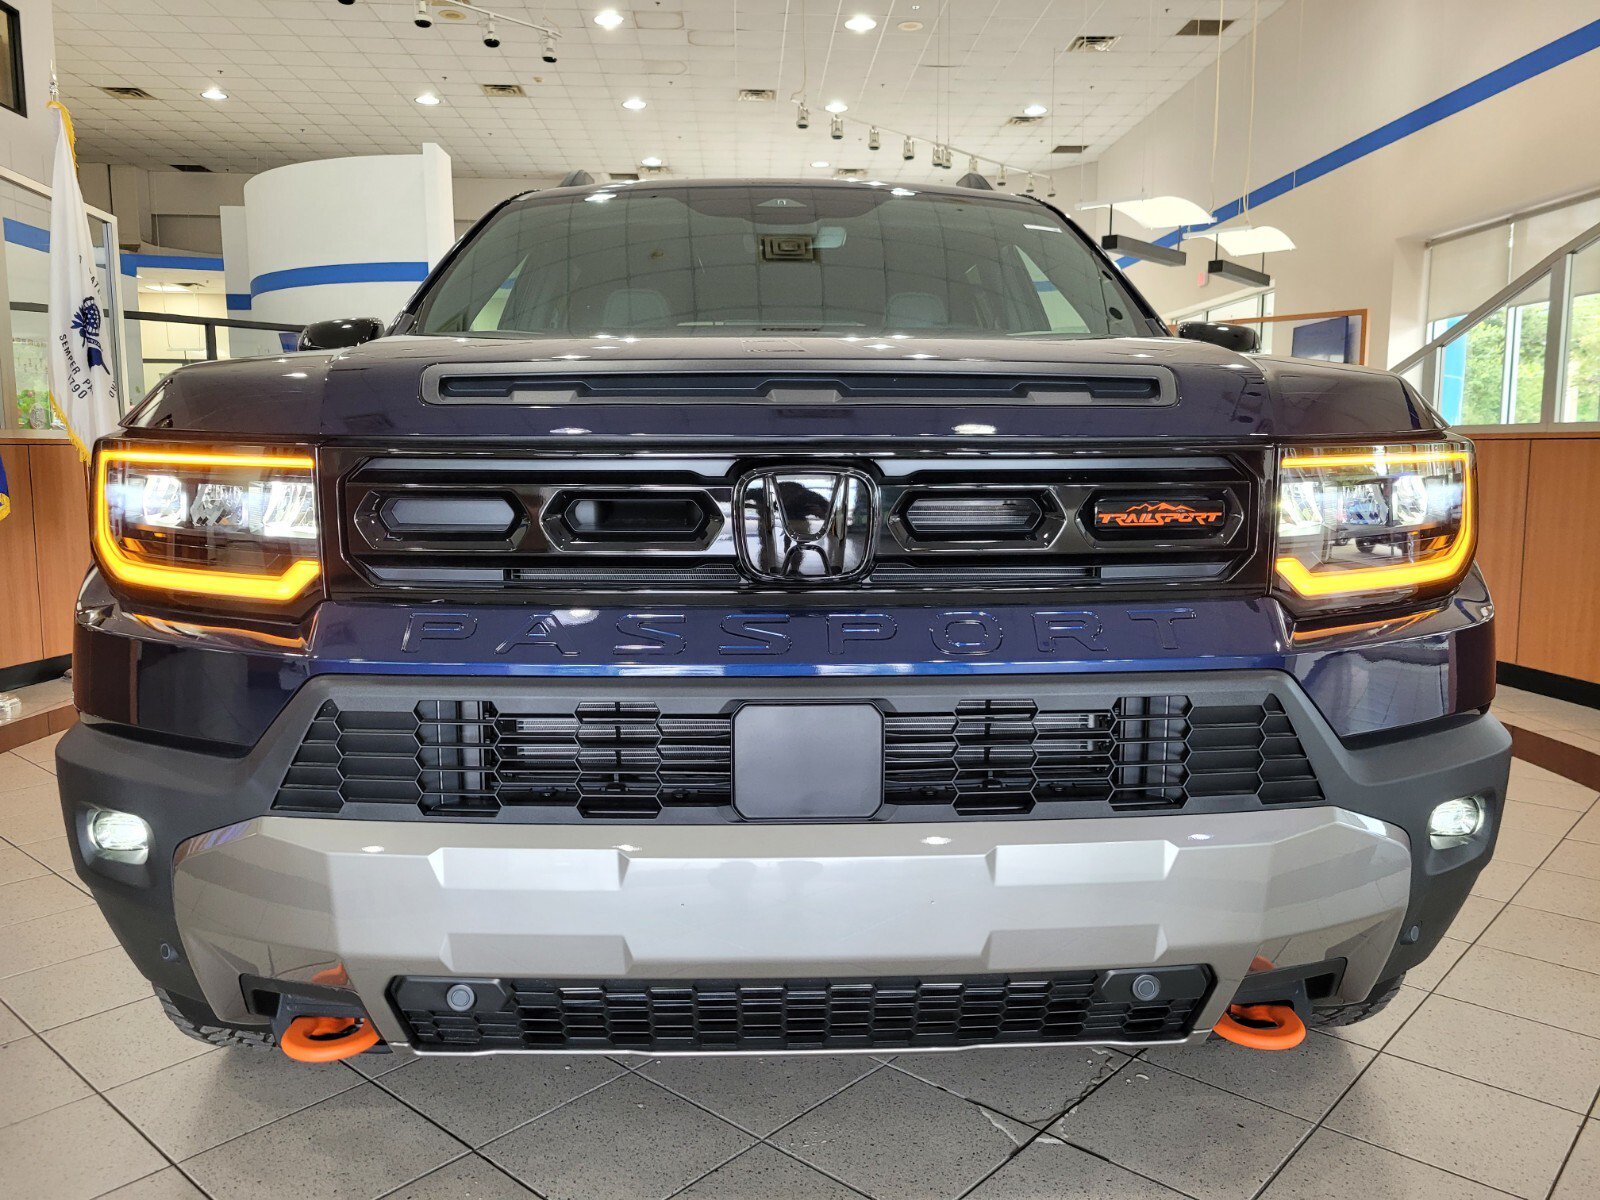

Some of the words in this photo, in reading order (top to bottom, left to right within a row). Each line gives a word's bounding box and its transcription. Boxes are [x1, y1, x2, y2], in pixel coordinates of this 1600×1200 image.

[59, 333, 81, 375] SEMPER
[67, 374, 88, 399] 1790
[1098, 511, 1223, 527] TRAILSPORT
[401, 607, 1198, 657] PASSPORT
